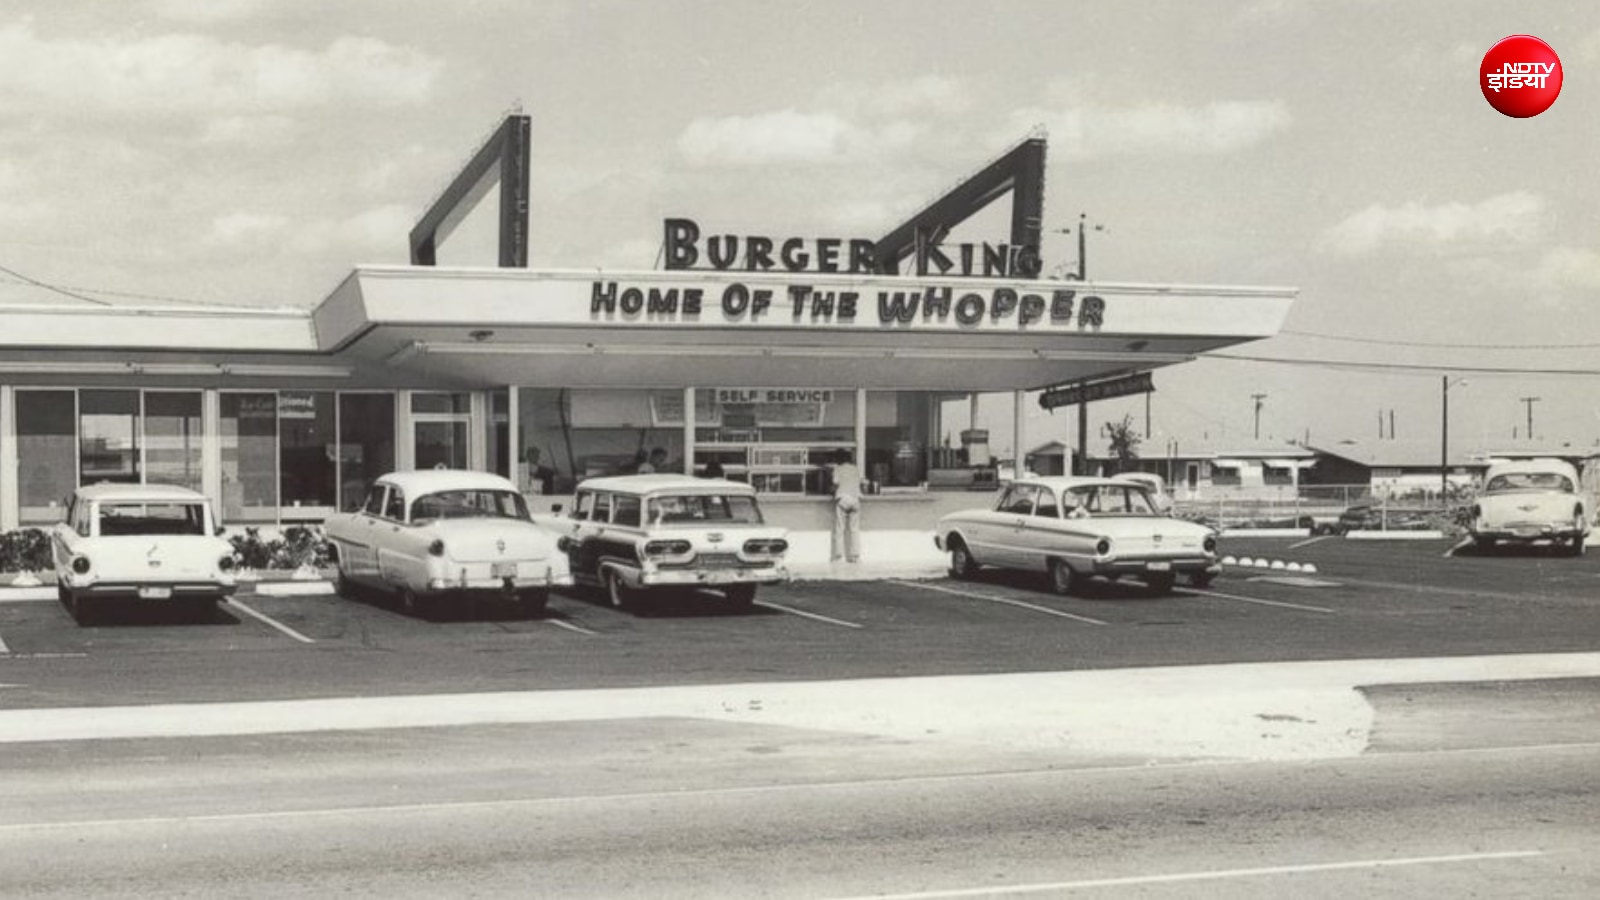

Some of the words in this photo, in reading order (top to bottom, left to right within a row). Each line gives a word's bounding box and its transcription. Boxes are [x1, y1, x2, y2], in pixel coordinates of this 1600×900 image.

[664, 218, 878, 272] BURGER
[914, 224, 1043, 278] KING
[591, 281, 703, 315] HOME
[721, 283, 773, 316] OF
[788, 285, 858, 318] THE
[877, 286, 1106, 327] WHOPPER
[719, 390, 759, 402] SELF
[766, 390, 832, 402] SERVICE
